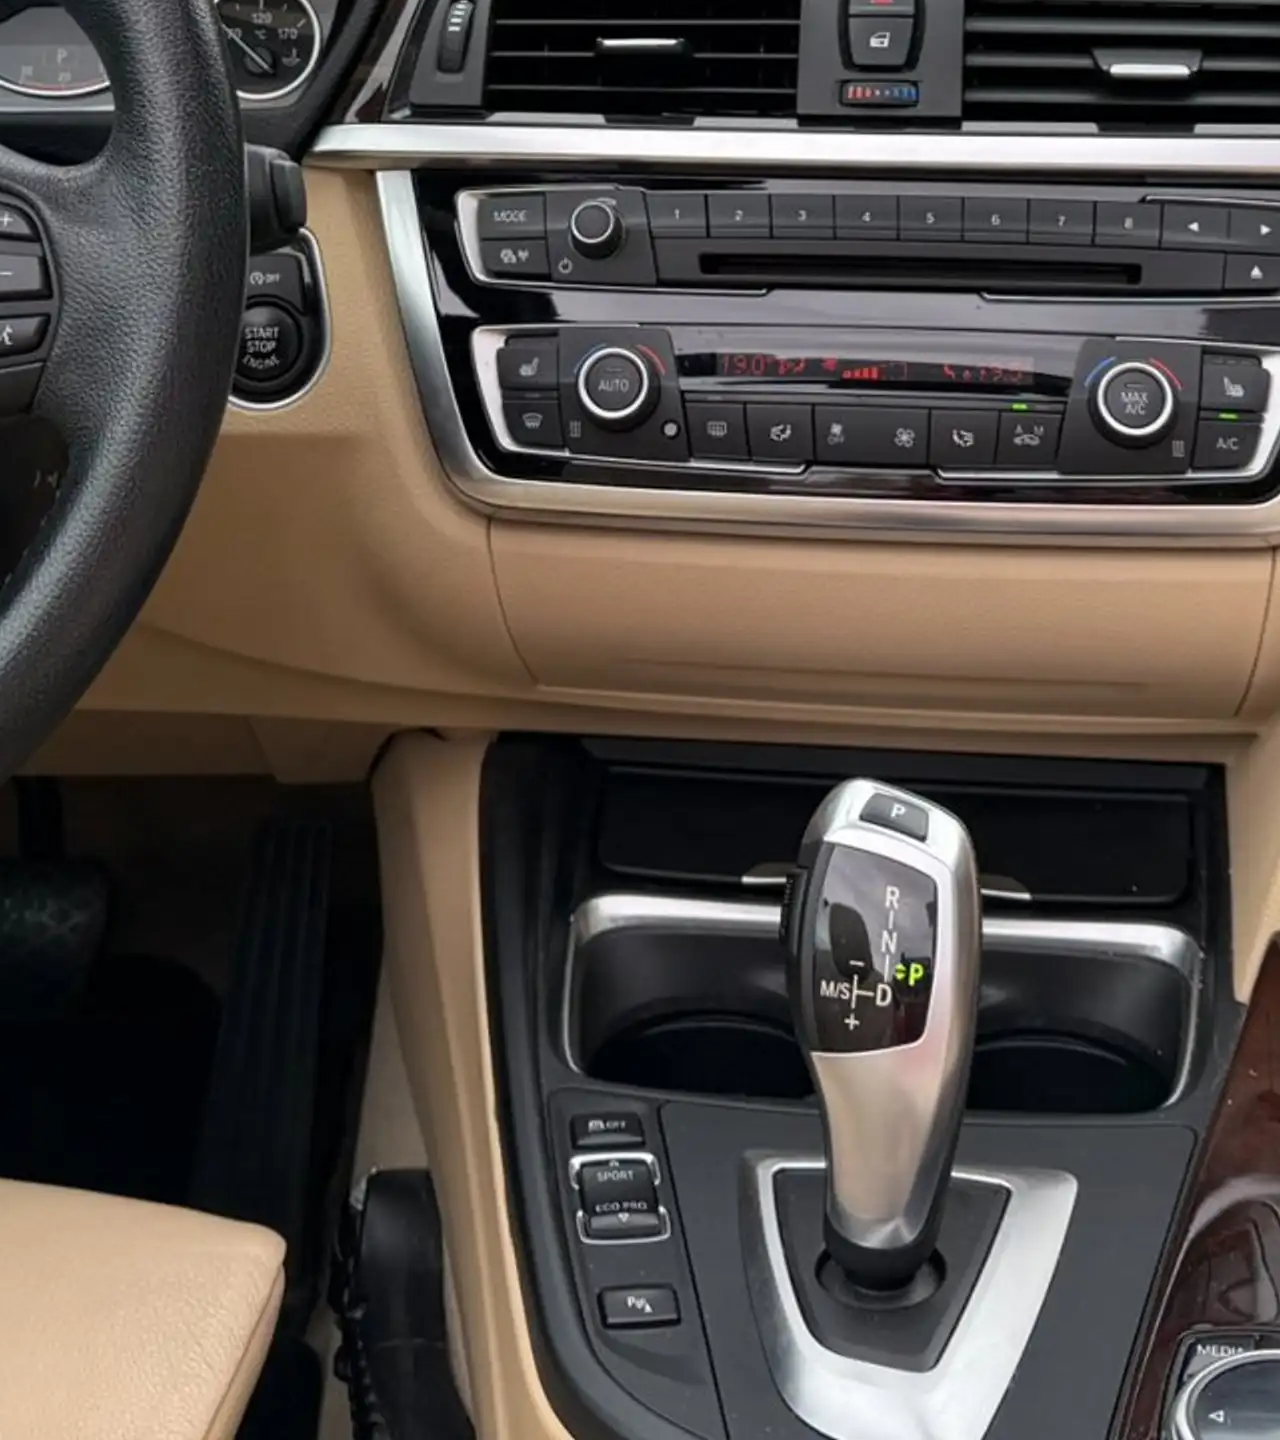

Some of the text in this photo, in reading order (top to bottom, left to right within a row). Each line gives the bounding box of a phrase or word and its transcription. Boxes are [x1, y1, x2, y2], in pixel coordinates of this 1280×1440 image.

[251, 12, 273, 24] 120
[278, 28, 298, 39] 170
[494, 210, 527, 222] MODE
[673, 209, 680, 220] 1
[735, 210, 743, 221] 2
[798, 210, 806, 221] 3
[862, 211, 870, 223] 4
[926, 212, 935, 224] 5
[991, 213, 1000, 226] 6
[1058, 215, 1066, 228] 7
[244, 326, 280, 339] START
[245, 340, 277, 353] STOP
[597, 379, 630, 393] AUTO
[1120, 391, 1148, 404] MAX
[1125, 403, 1146, 416] A/C
[1216, 437, 1239, 450] A/C
[890, 803, 906, 818] P
[885, 886, 900, 909] R
[881, 930, 897, 955] N
[908, 963, 924, 987] P
[820, 980, 892, 1007] M/S D
[596, 1170, 634, 1182] SPORT
[1196, 1343, 1245, 1358] MEDIA
